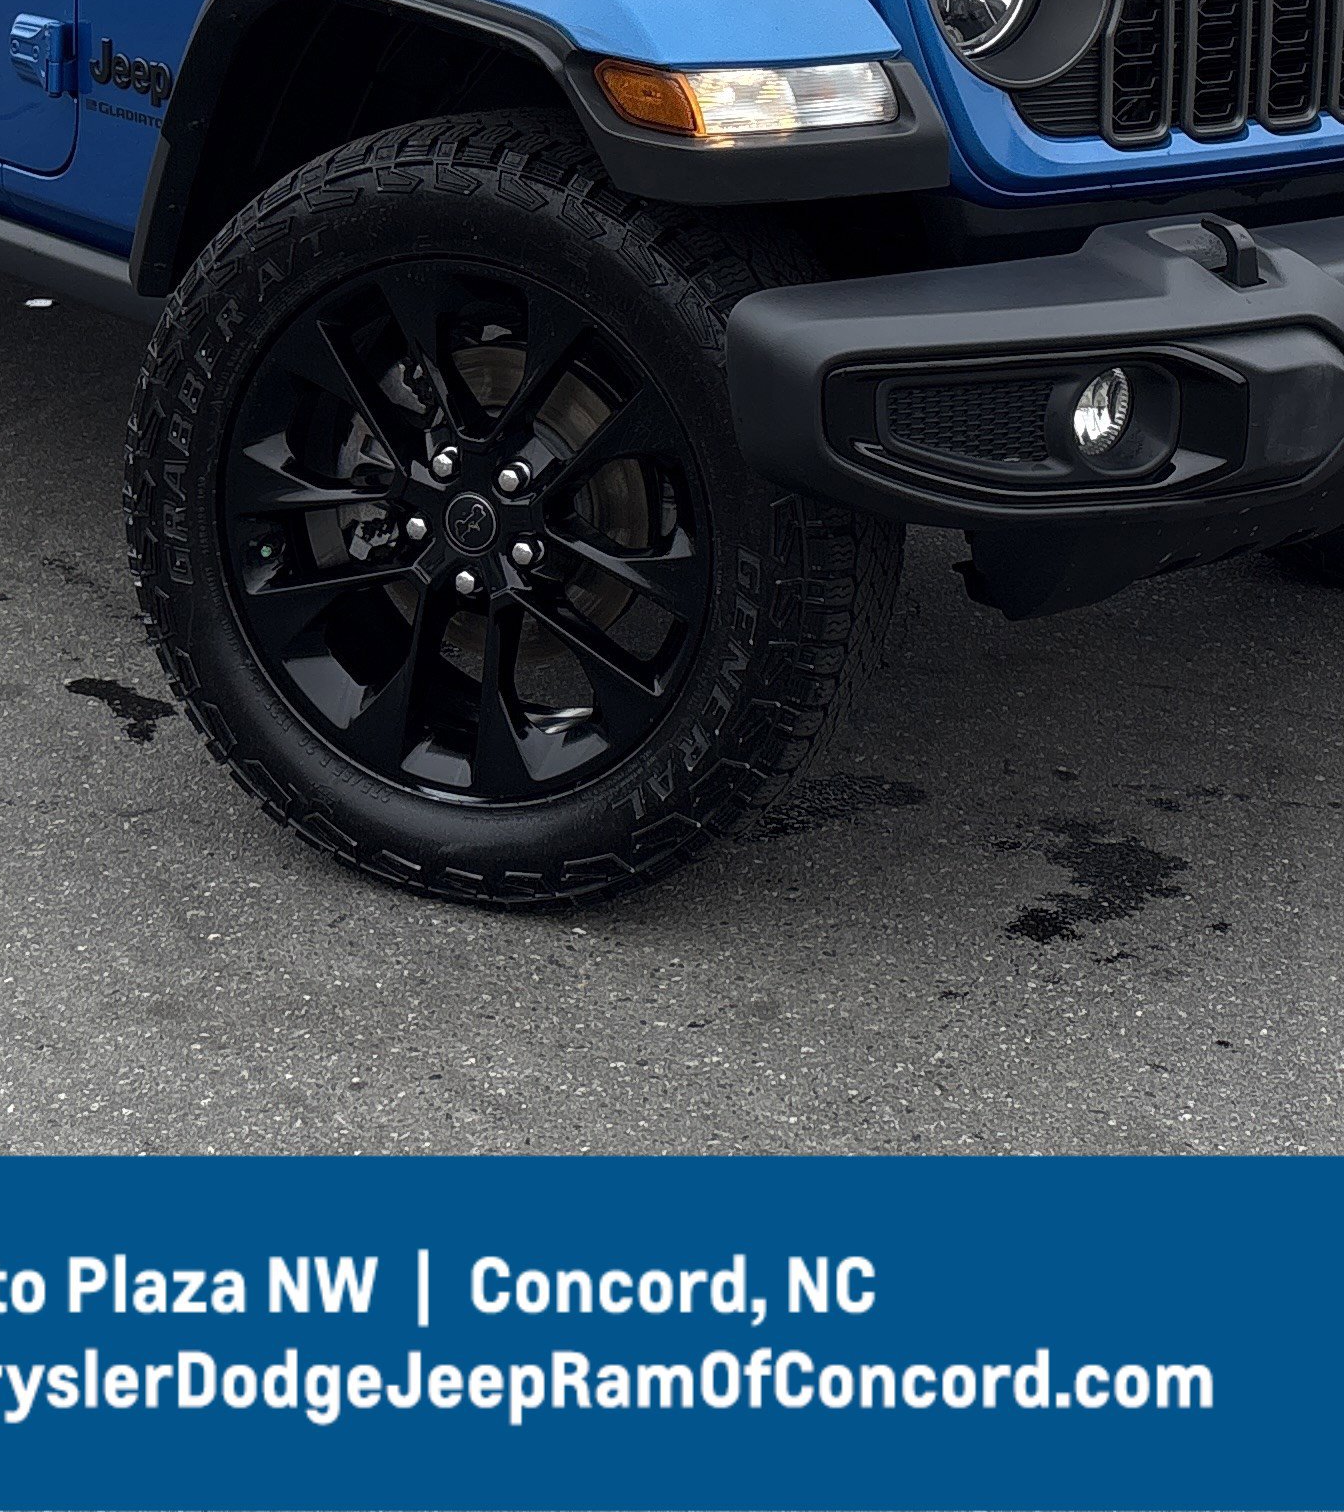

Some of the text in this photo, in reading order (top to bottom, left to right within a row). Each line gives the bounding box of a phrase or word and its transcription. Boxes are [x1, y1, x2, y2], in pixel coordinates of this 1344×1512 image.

[90, 37, 172, 108] Jeep
[98, 101, 163, 129] GLADIATO
[159, 222, 328, 585] GRABBER A/T
[611, 544, 761, 821] GENERAL
